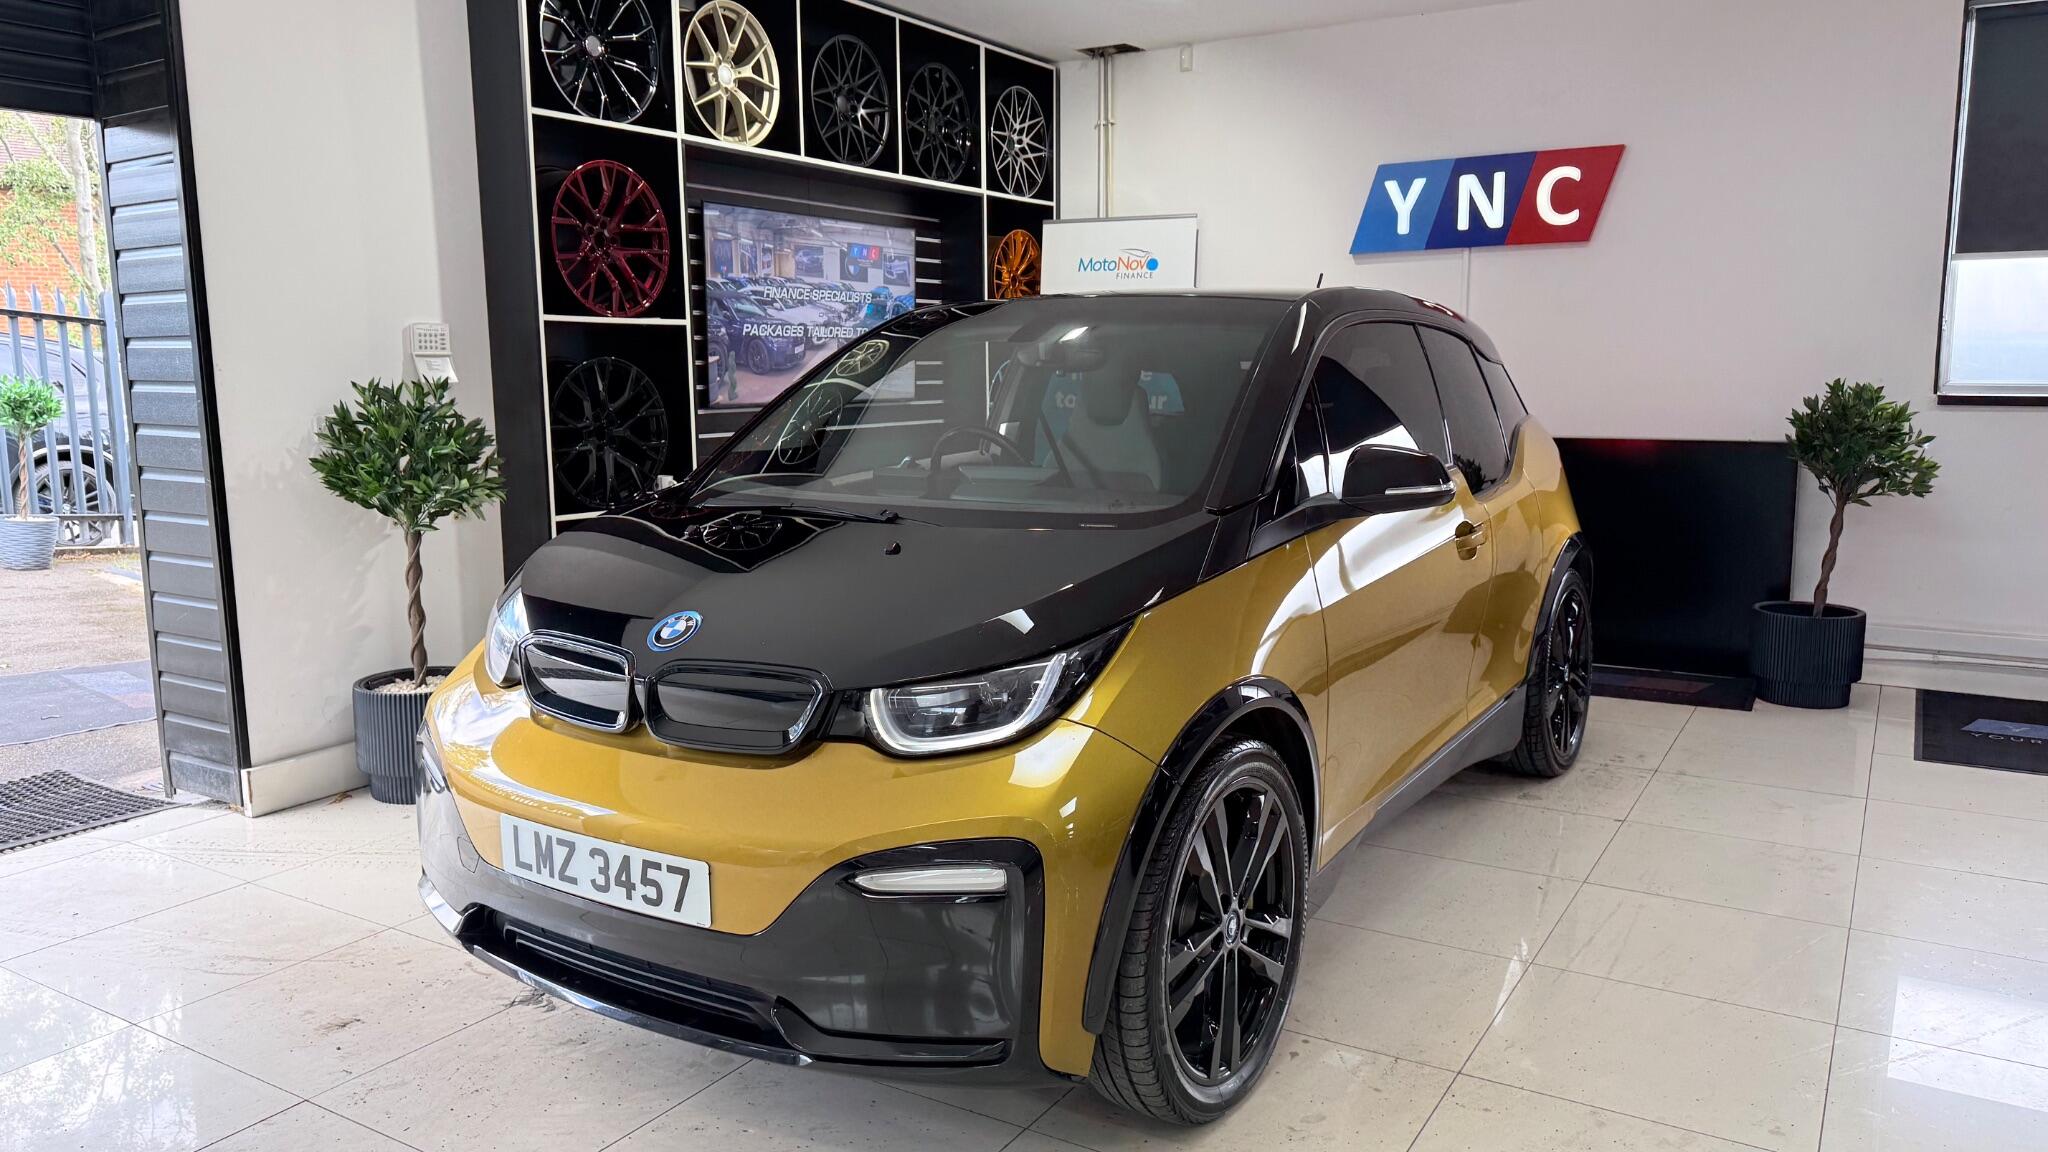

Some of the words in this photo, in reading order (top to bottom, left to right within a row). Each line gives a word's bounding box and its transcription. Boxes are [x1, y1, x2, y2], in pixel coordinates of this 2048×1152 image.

[1383, 165, 1582, 235] YNC
[1115, 272, 1154, 280] FINANCE
[763, 286, 811, 300] FINANCE
[812, 290, 873, 303] SPECIALISTS
[742, 323, 804, 337] PACKAGES
[807, 325, 854, 338] TAILORED
[512, 824, 578, 886] LMZ
[588, 847, 691, 913] 3457
